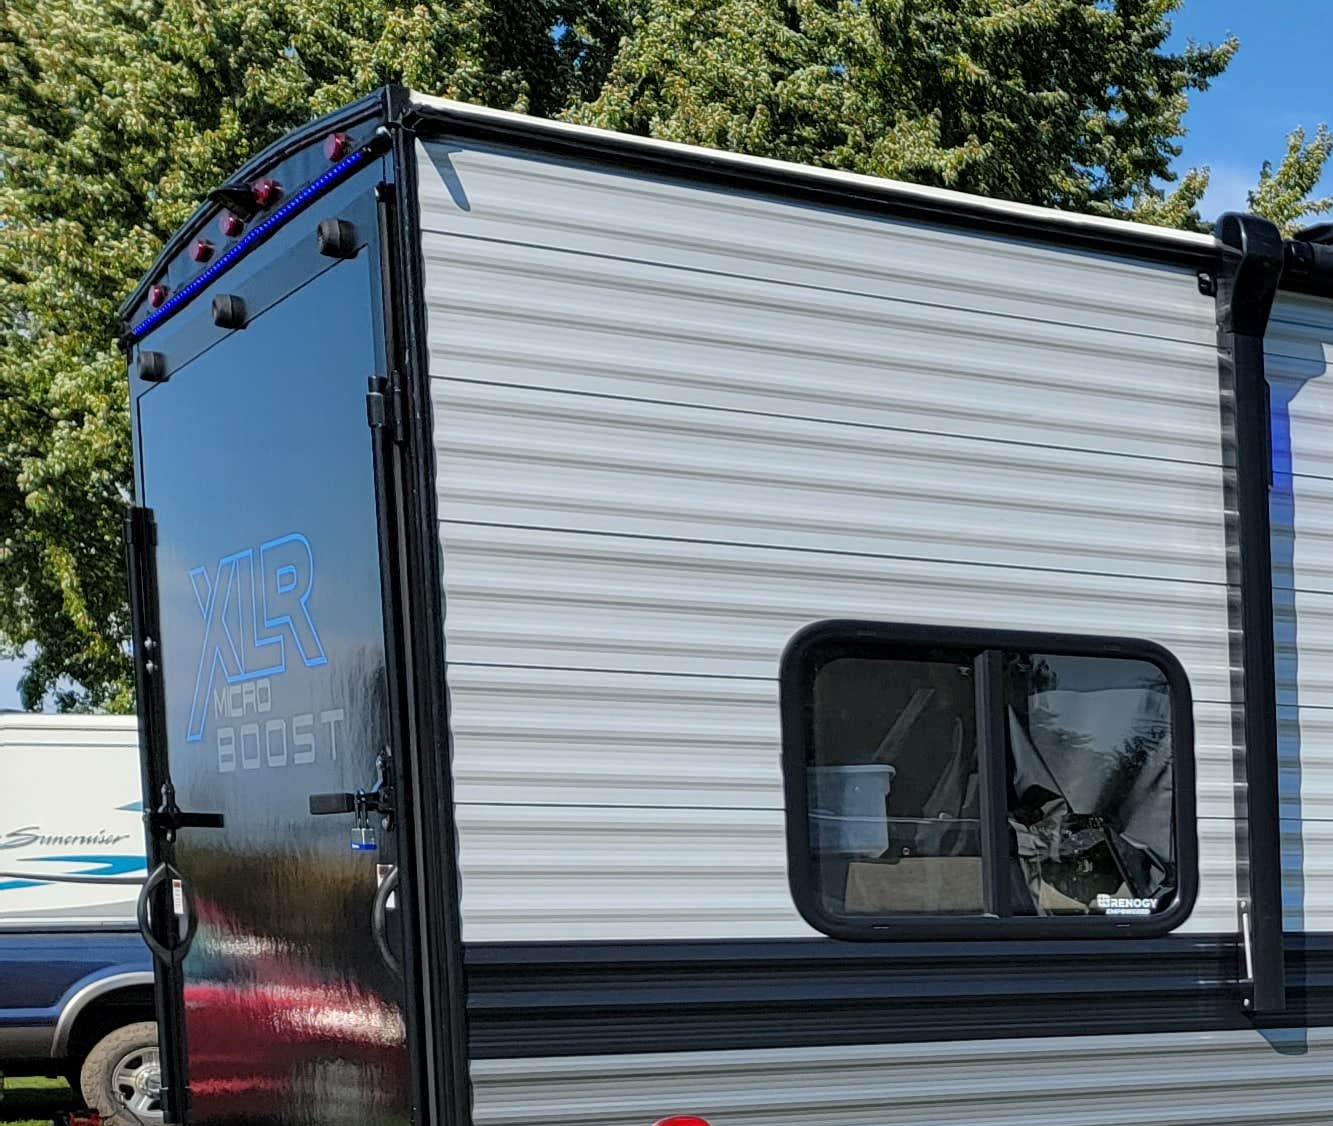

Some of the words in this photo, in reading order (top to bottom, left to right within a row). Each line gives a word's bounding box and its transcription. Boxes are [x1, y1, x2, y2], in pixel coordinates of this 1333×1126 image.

[186, 532, 328, 742] XLR
[213, 678, 272, 719] MICRO
[217, 708, 345, 773] BOOST
[1110, 898, 1158, 909] RENOGY
